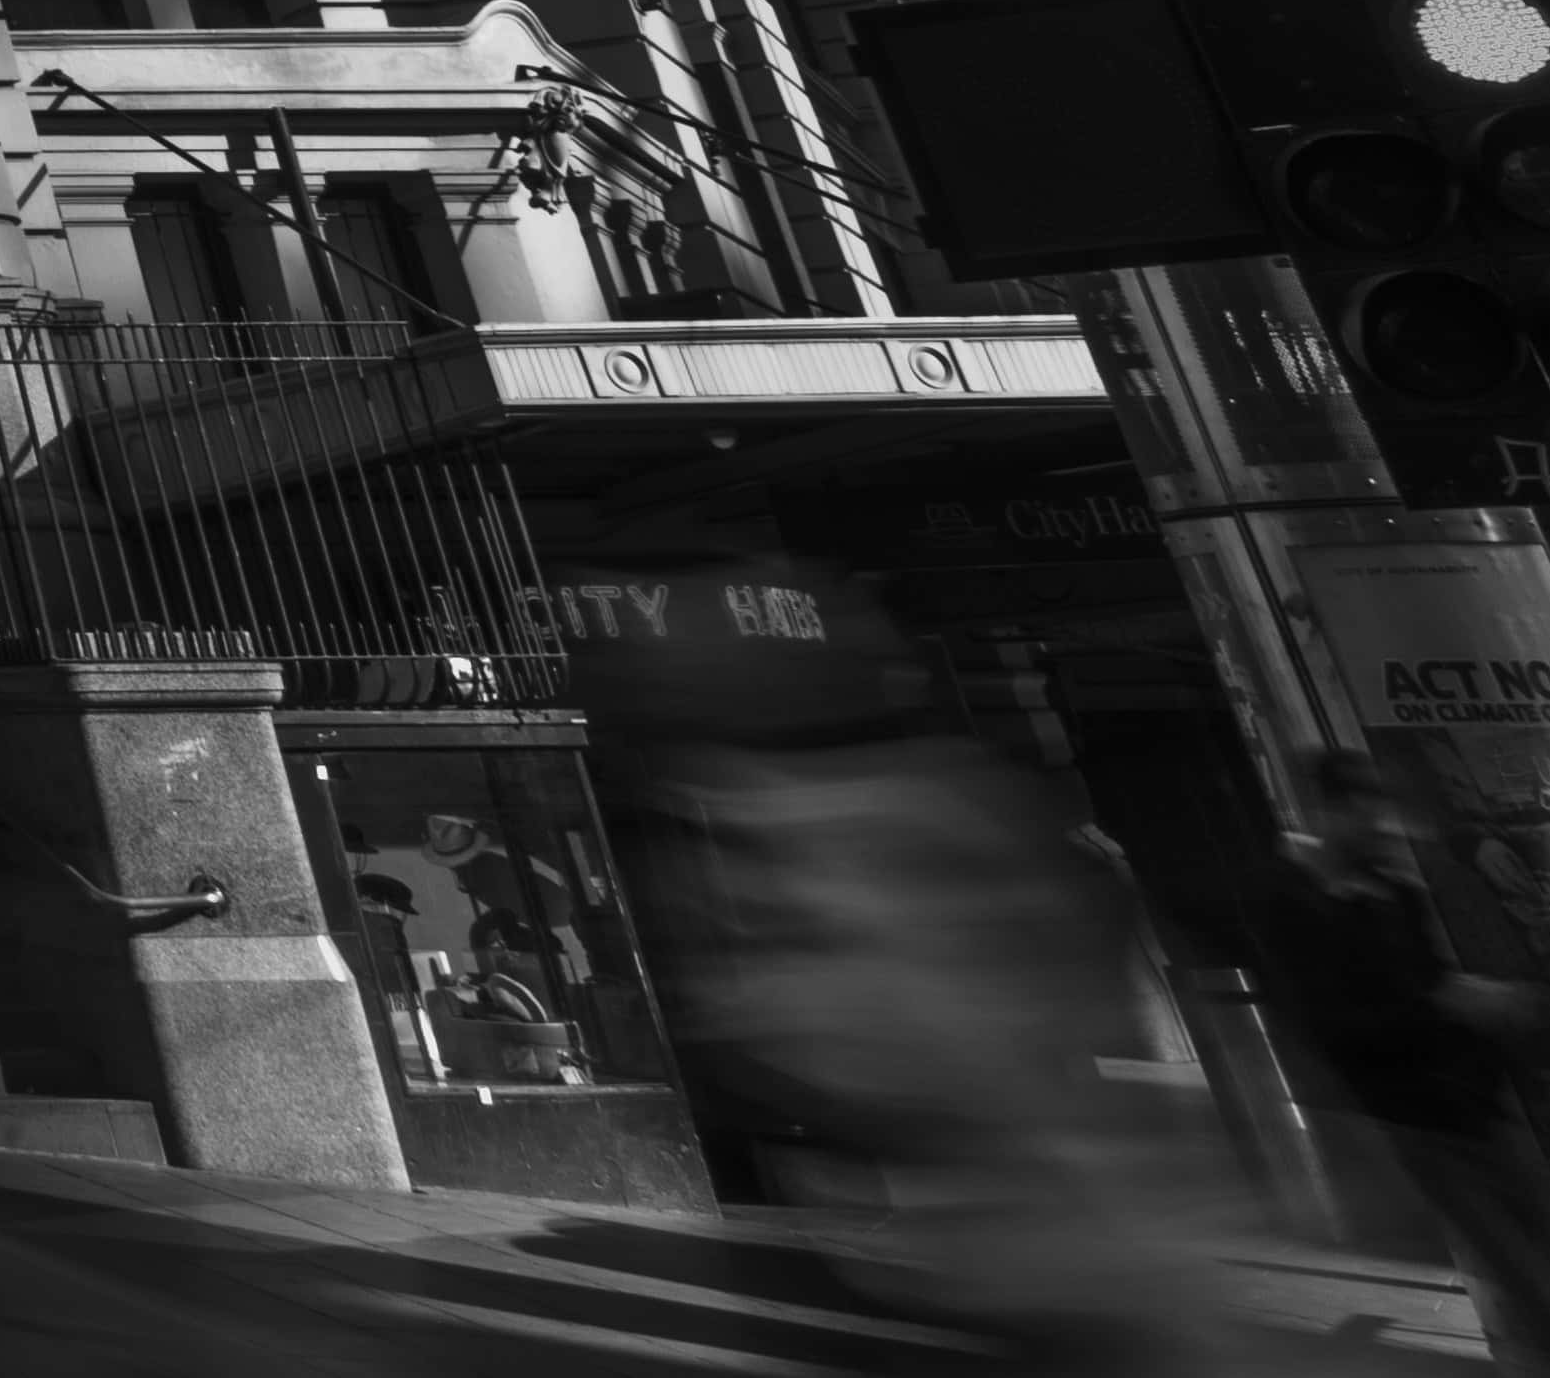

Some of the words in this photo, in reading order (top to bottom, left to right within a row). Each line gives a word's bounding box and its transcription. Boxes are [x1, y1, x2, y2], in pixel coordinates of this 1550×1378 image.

[513, 584, 669, 640] CITY
[1384, 660, 1480, 699] ACT
[1393, 704, 1433, 722] ON
[1436, 704, 1542, 722] CLIMATE
